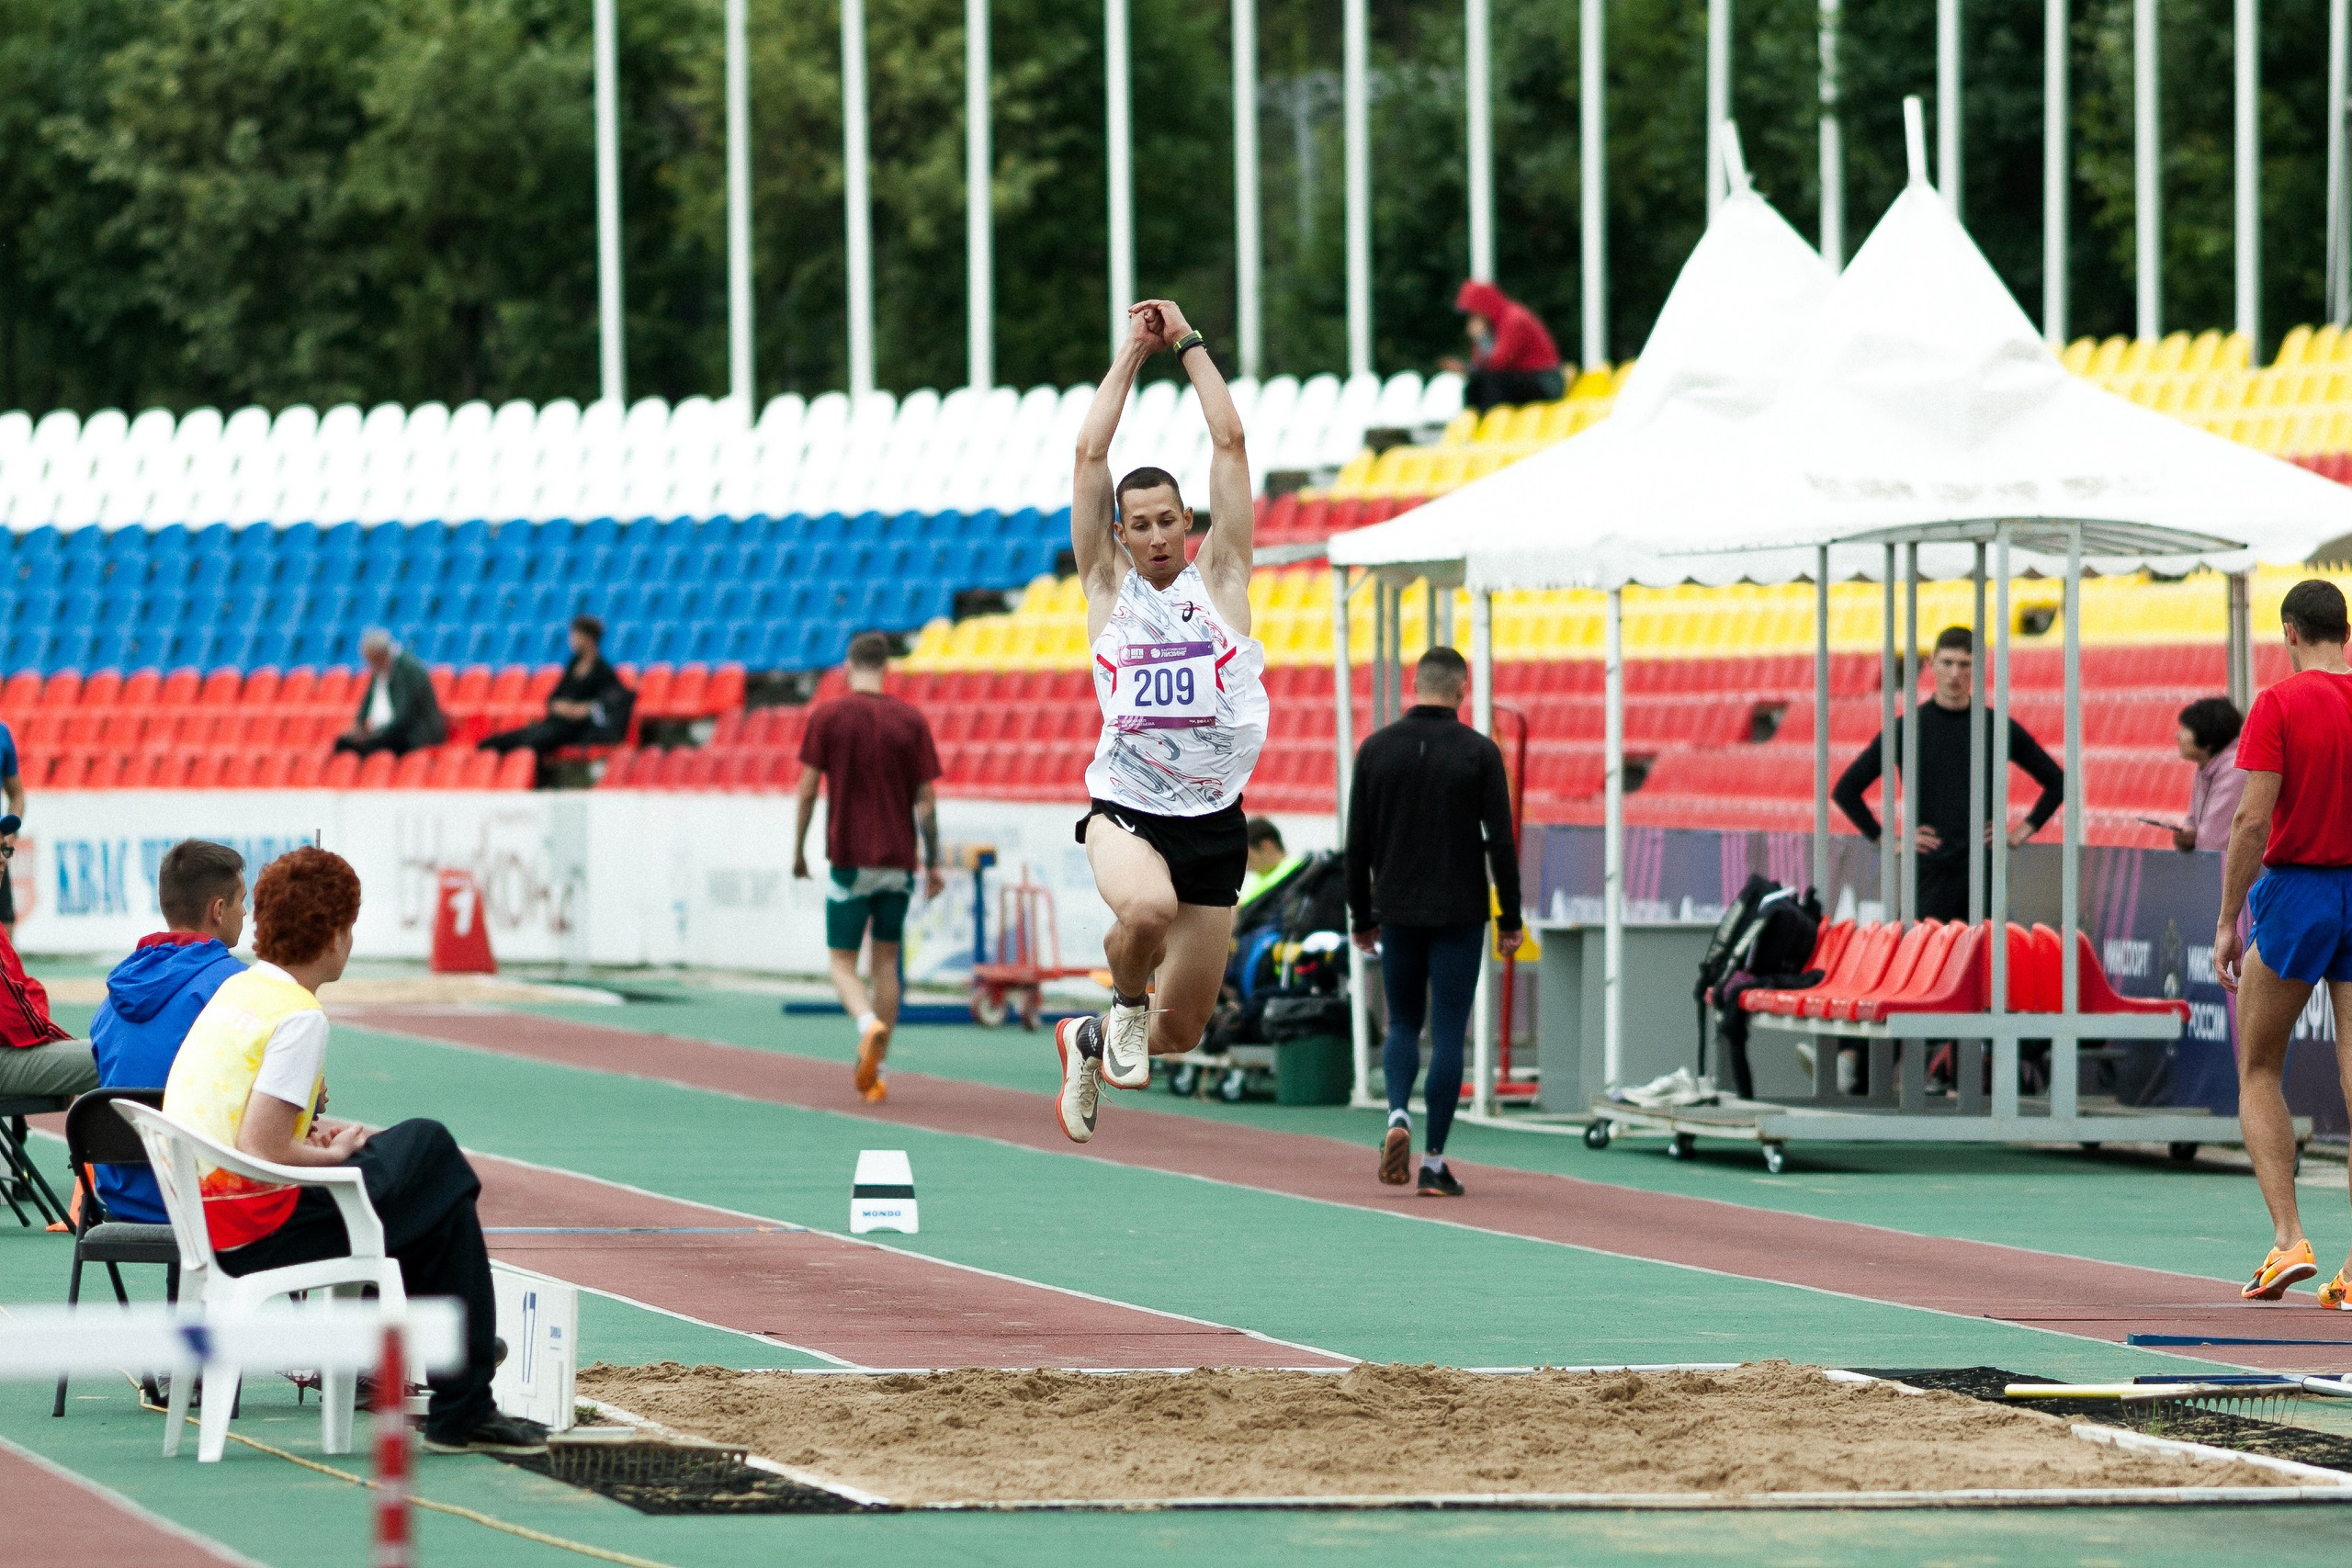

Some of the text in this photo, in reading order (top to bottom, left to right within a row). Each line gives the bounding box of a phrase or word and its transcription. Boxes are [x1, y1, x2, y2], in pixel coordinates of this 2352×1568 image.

[1134, 667, 1194, 706] 209
[54, 839, 128, 916] КВАС
[449, 888, 475, 937] 1
